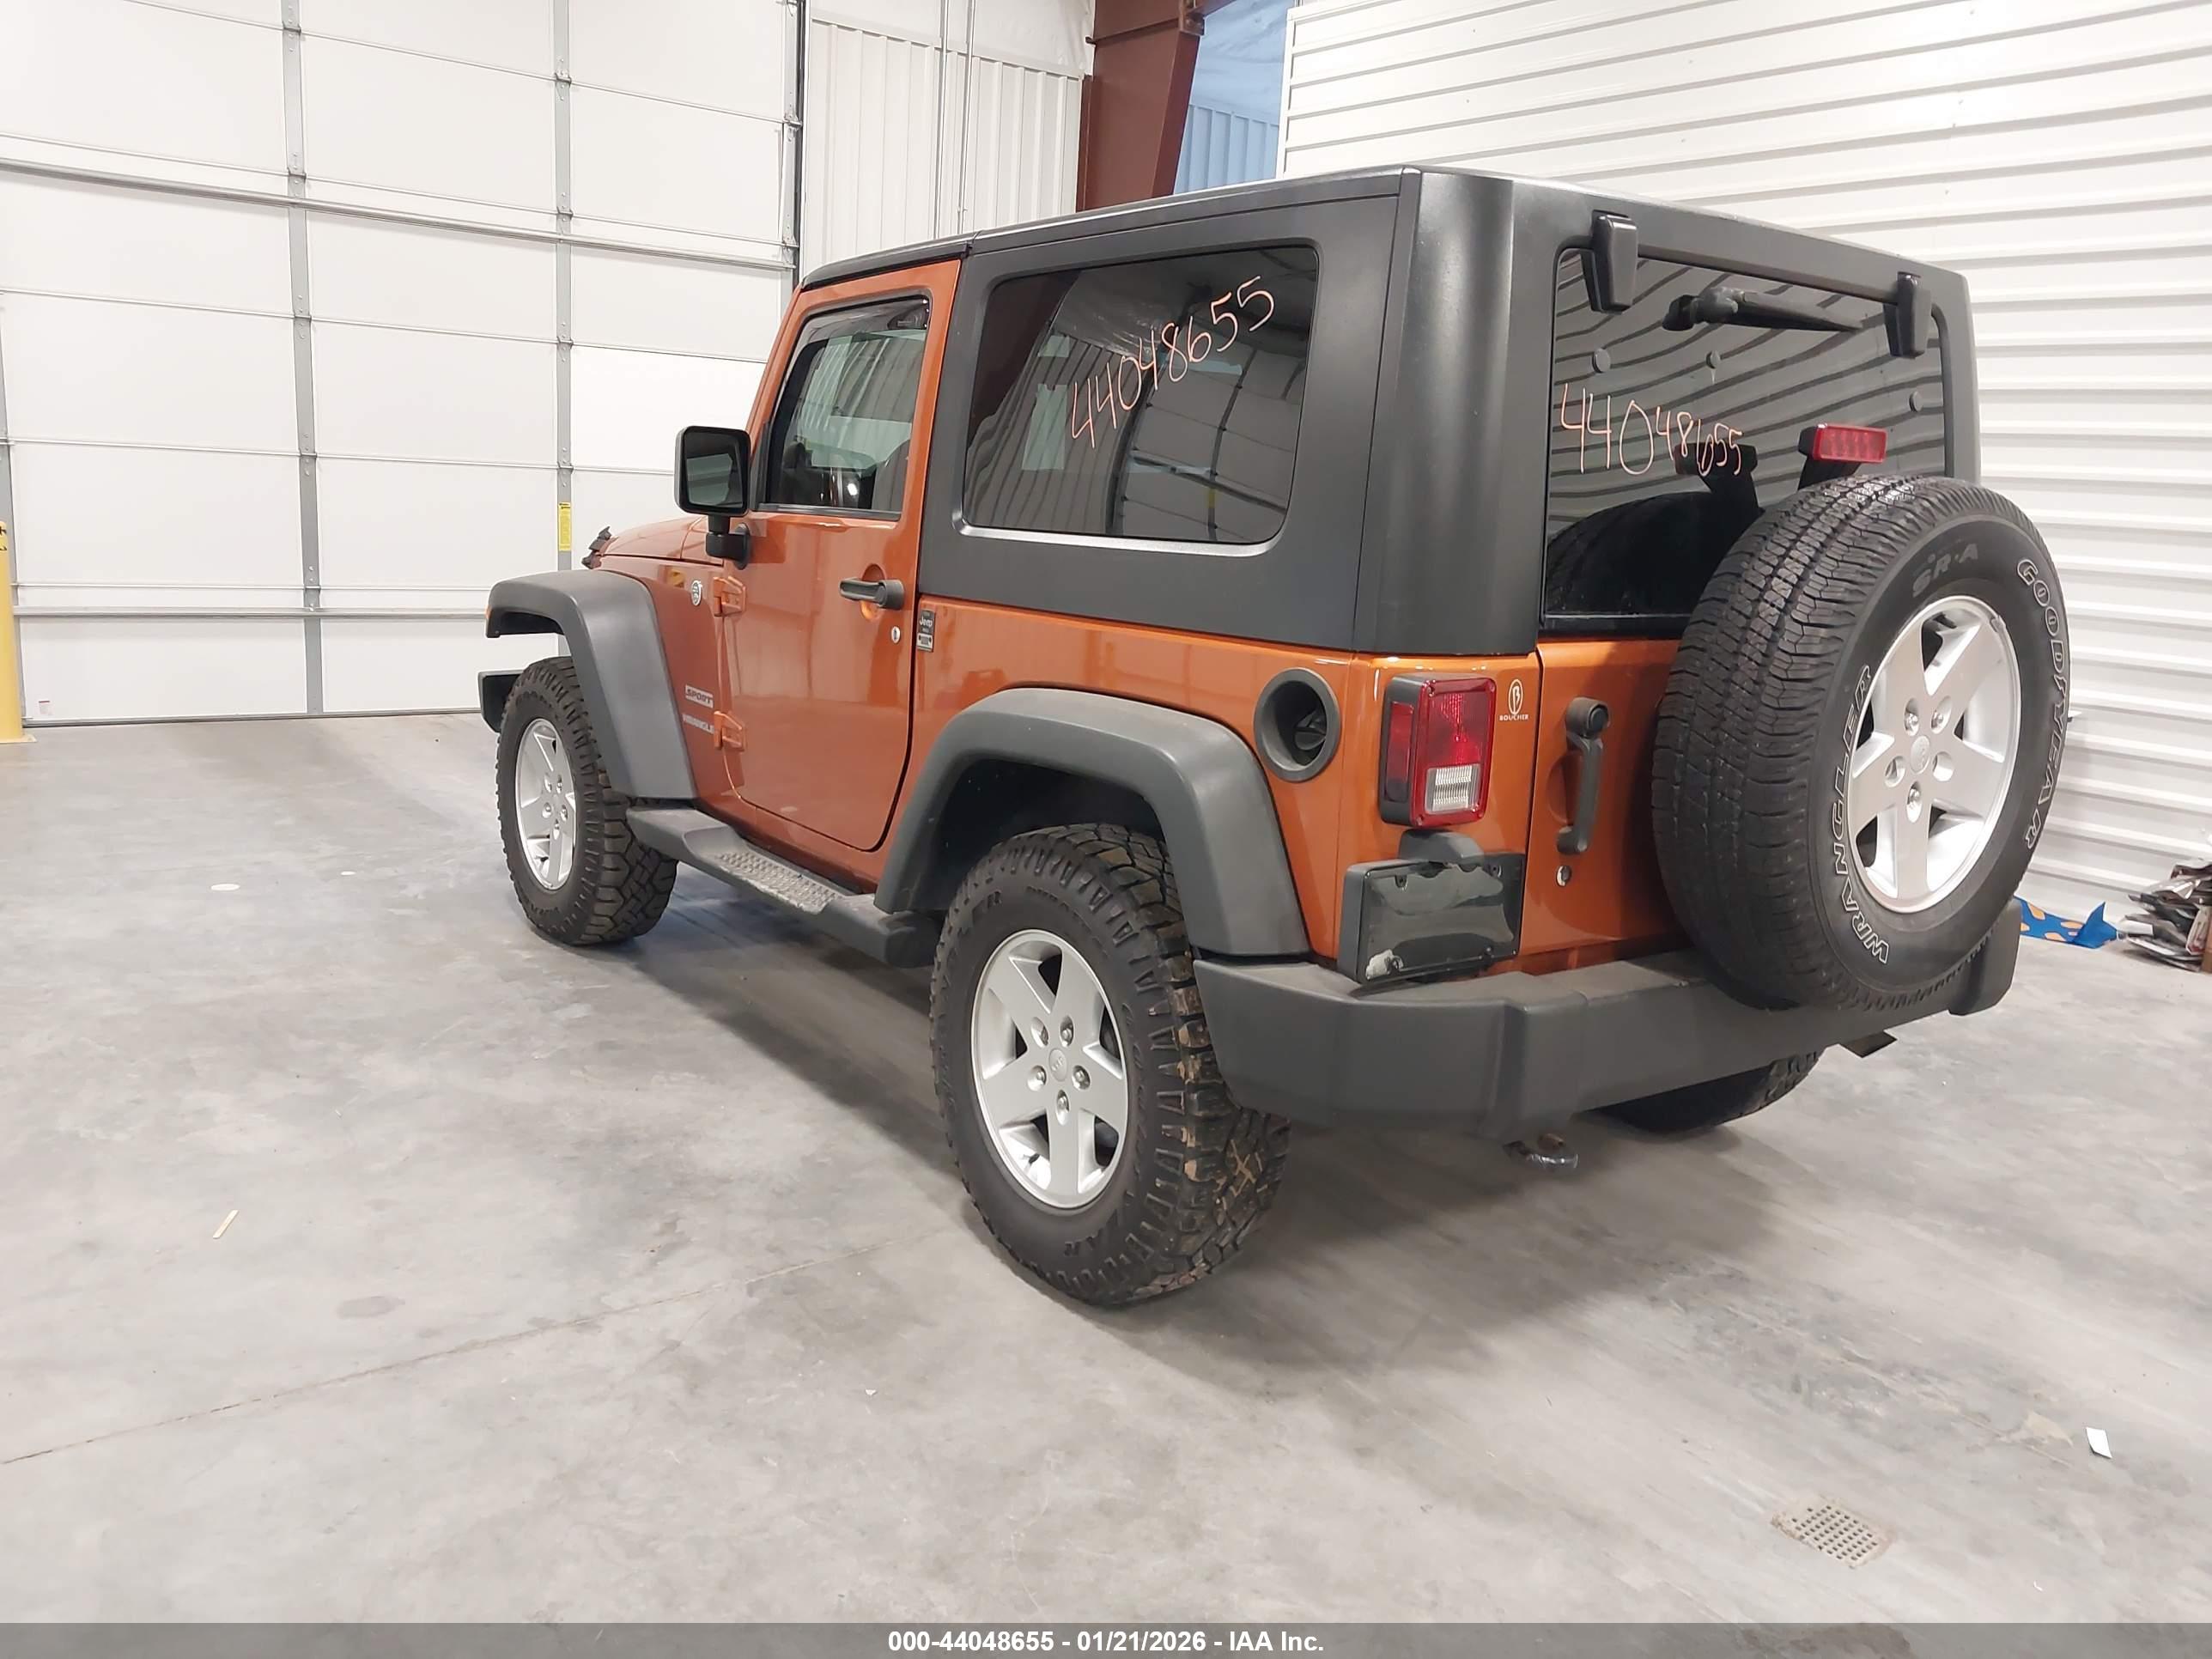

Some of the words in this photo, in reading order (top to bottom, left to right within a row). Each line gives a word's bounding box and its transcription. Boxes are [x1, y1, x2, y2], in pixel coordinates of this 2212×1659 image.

[1072, 276, 1274, 449] 44048655
[1560, 382, 1743, 477] 44048655
[1832, 665, 1889, 963] WRANGLER
[2017, 559, 2068, 849] GOODYEAR
